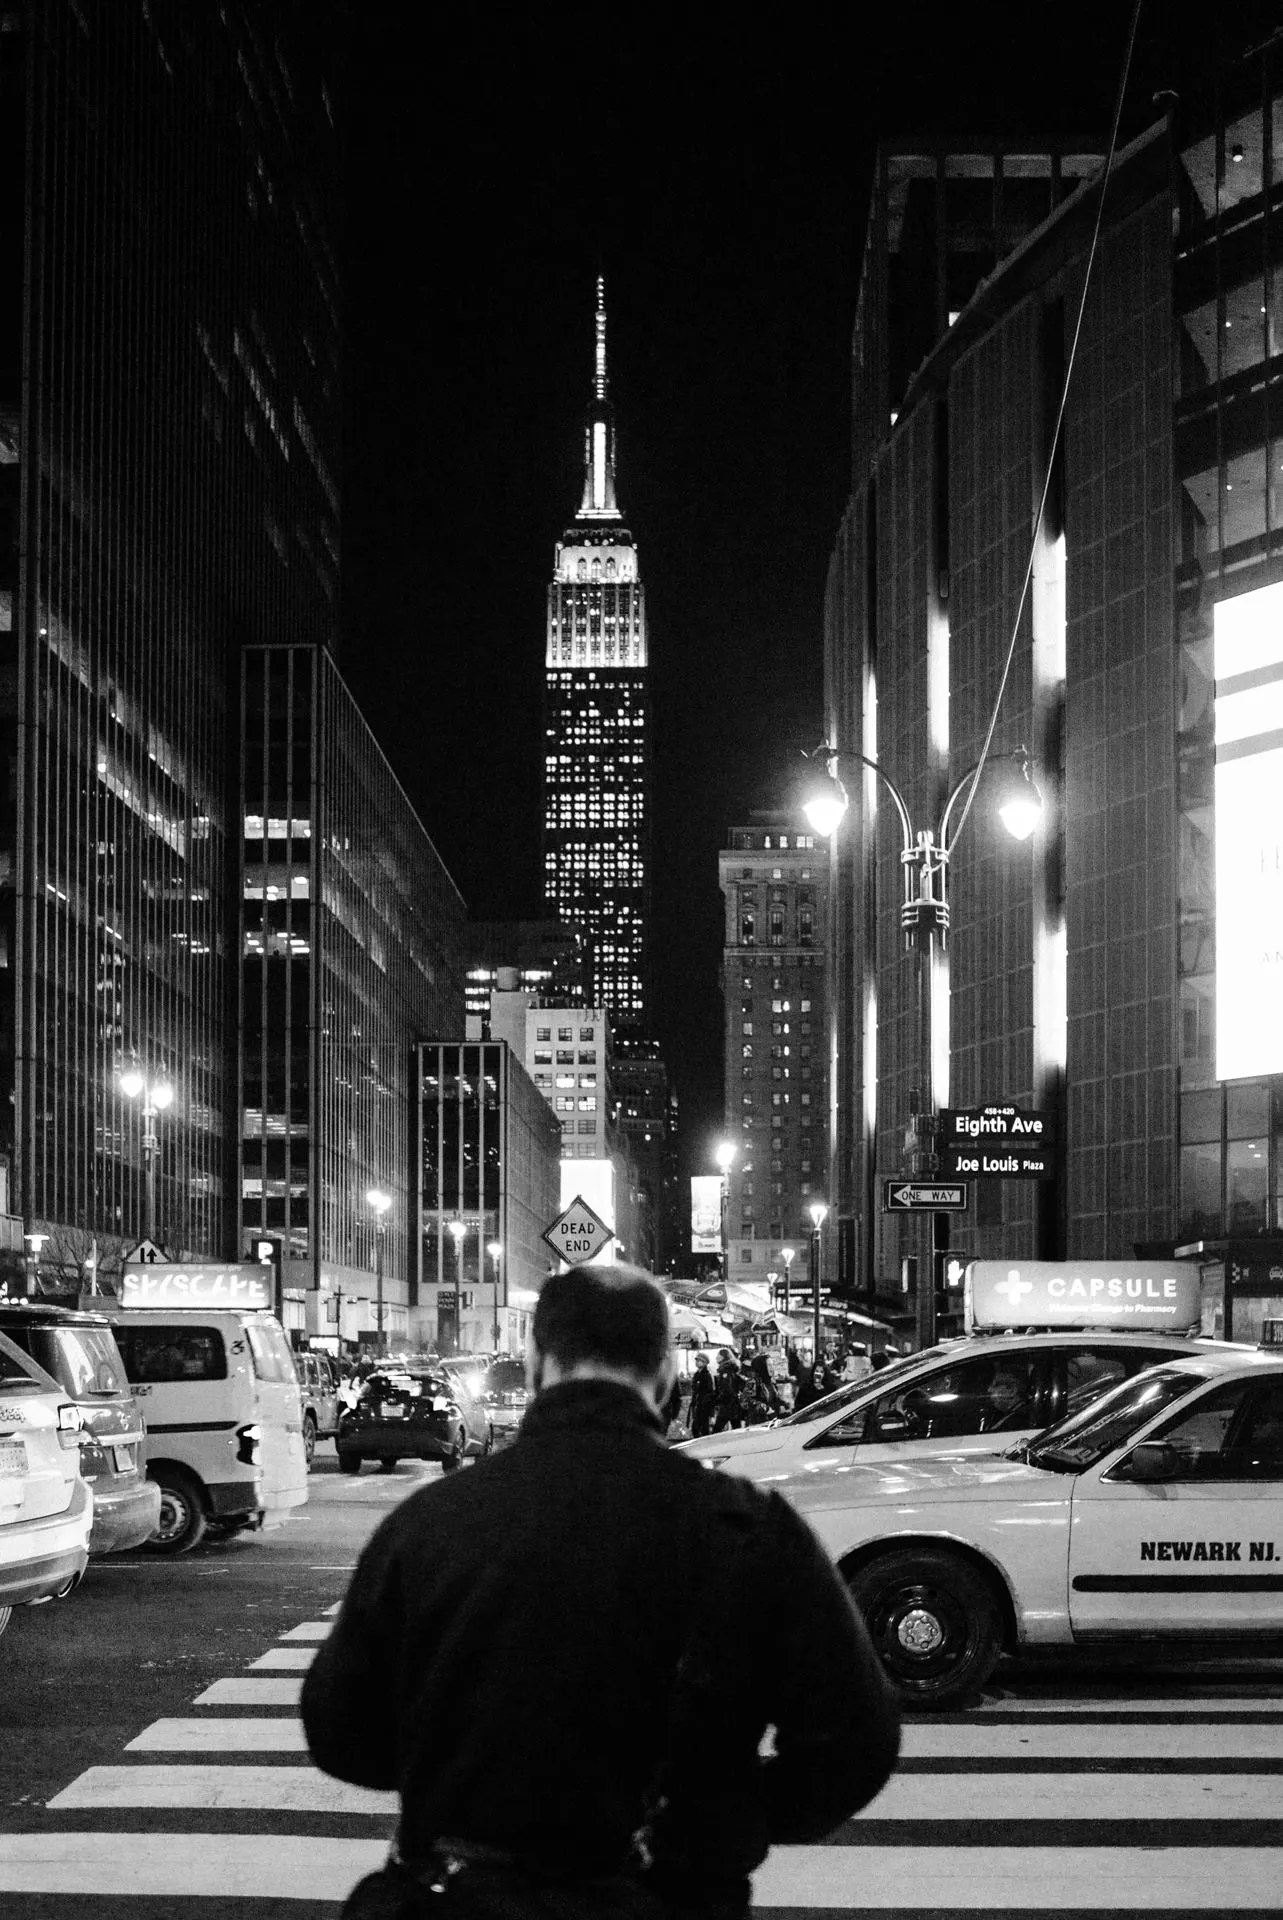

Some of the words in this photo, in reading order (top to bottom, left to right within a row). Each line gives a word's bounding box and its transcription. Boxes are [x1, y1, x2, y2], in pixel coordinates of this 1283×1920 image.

[955, 1116, 1007, 1137] Eighth
[1011, 1117, 1043, 1133] Ave
[955, 1156, 980, 1172] Joe
[982, 1155, 1019, 1172] Louis
[1023, 1160, 1044, 1170] Plaza
[901, 1191, 921, 1201] ONE
[931, 1191, 954, 1201] WAY
[561, 1223, 595, 1234] DEAD
[566, 1240, 591, 1252] END
[1047, 1278, 1177, 1298] CAPSULE
[1124, 1305, 1134, 1313] to
[1135, 1304, 1177, 1314] Pharmacy
[1140, 1541, 1241, 1561] NEWARK
[1249, 1541, 1281, 1562] NJ.
